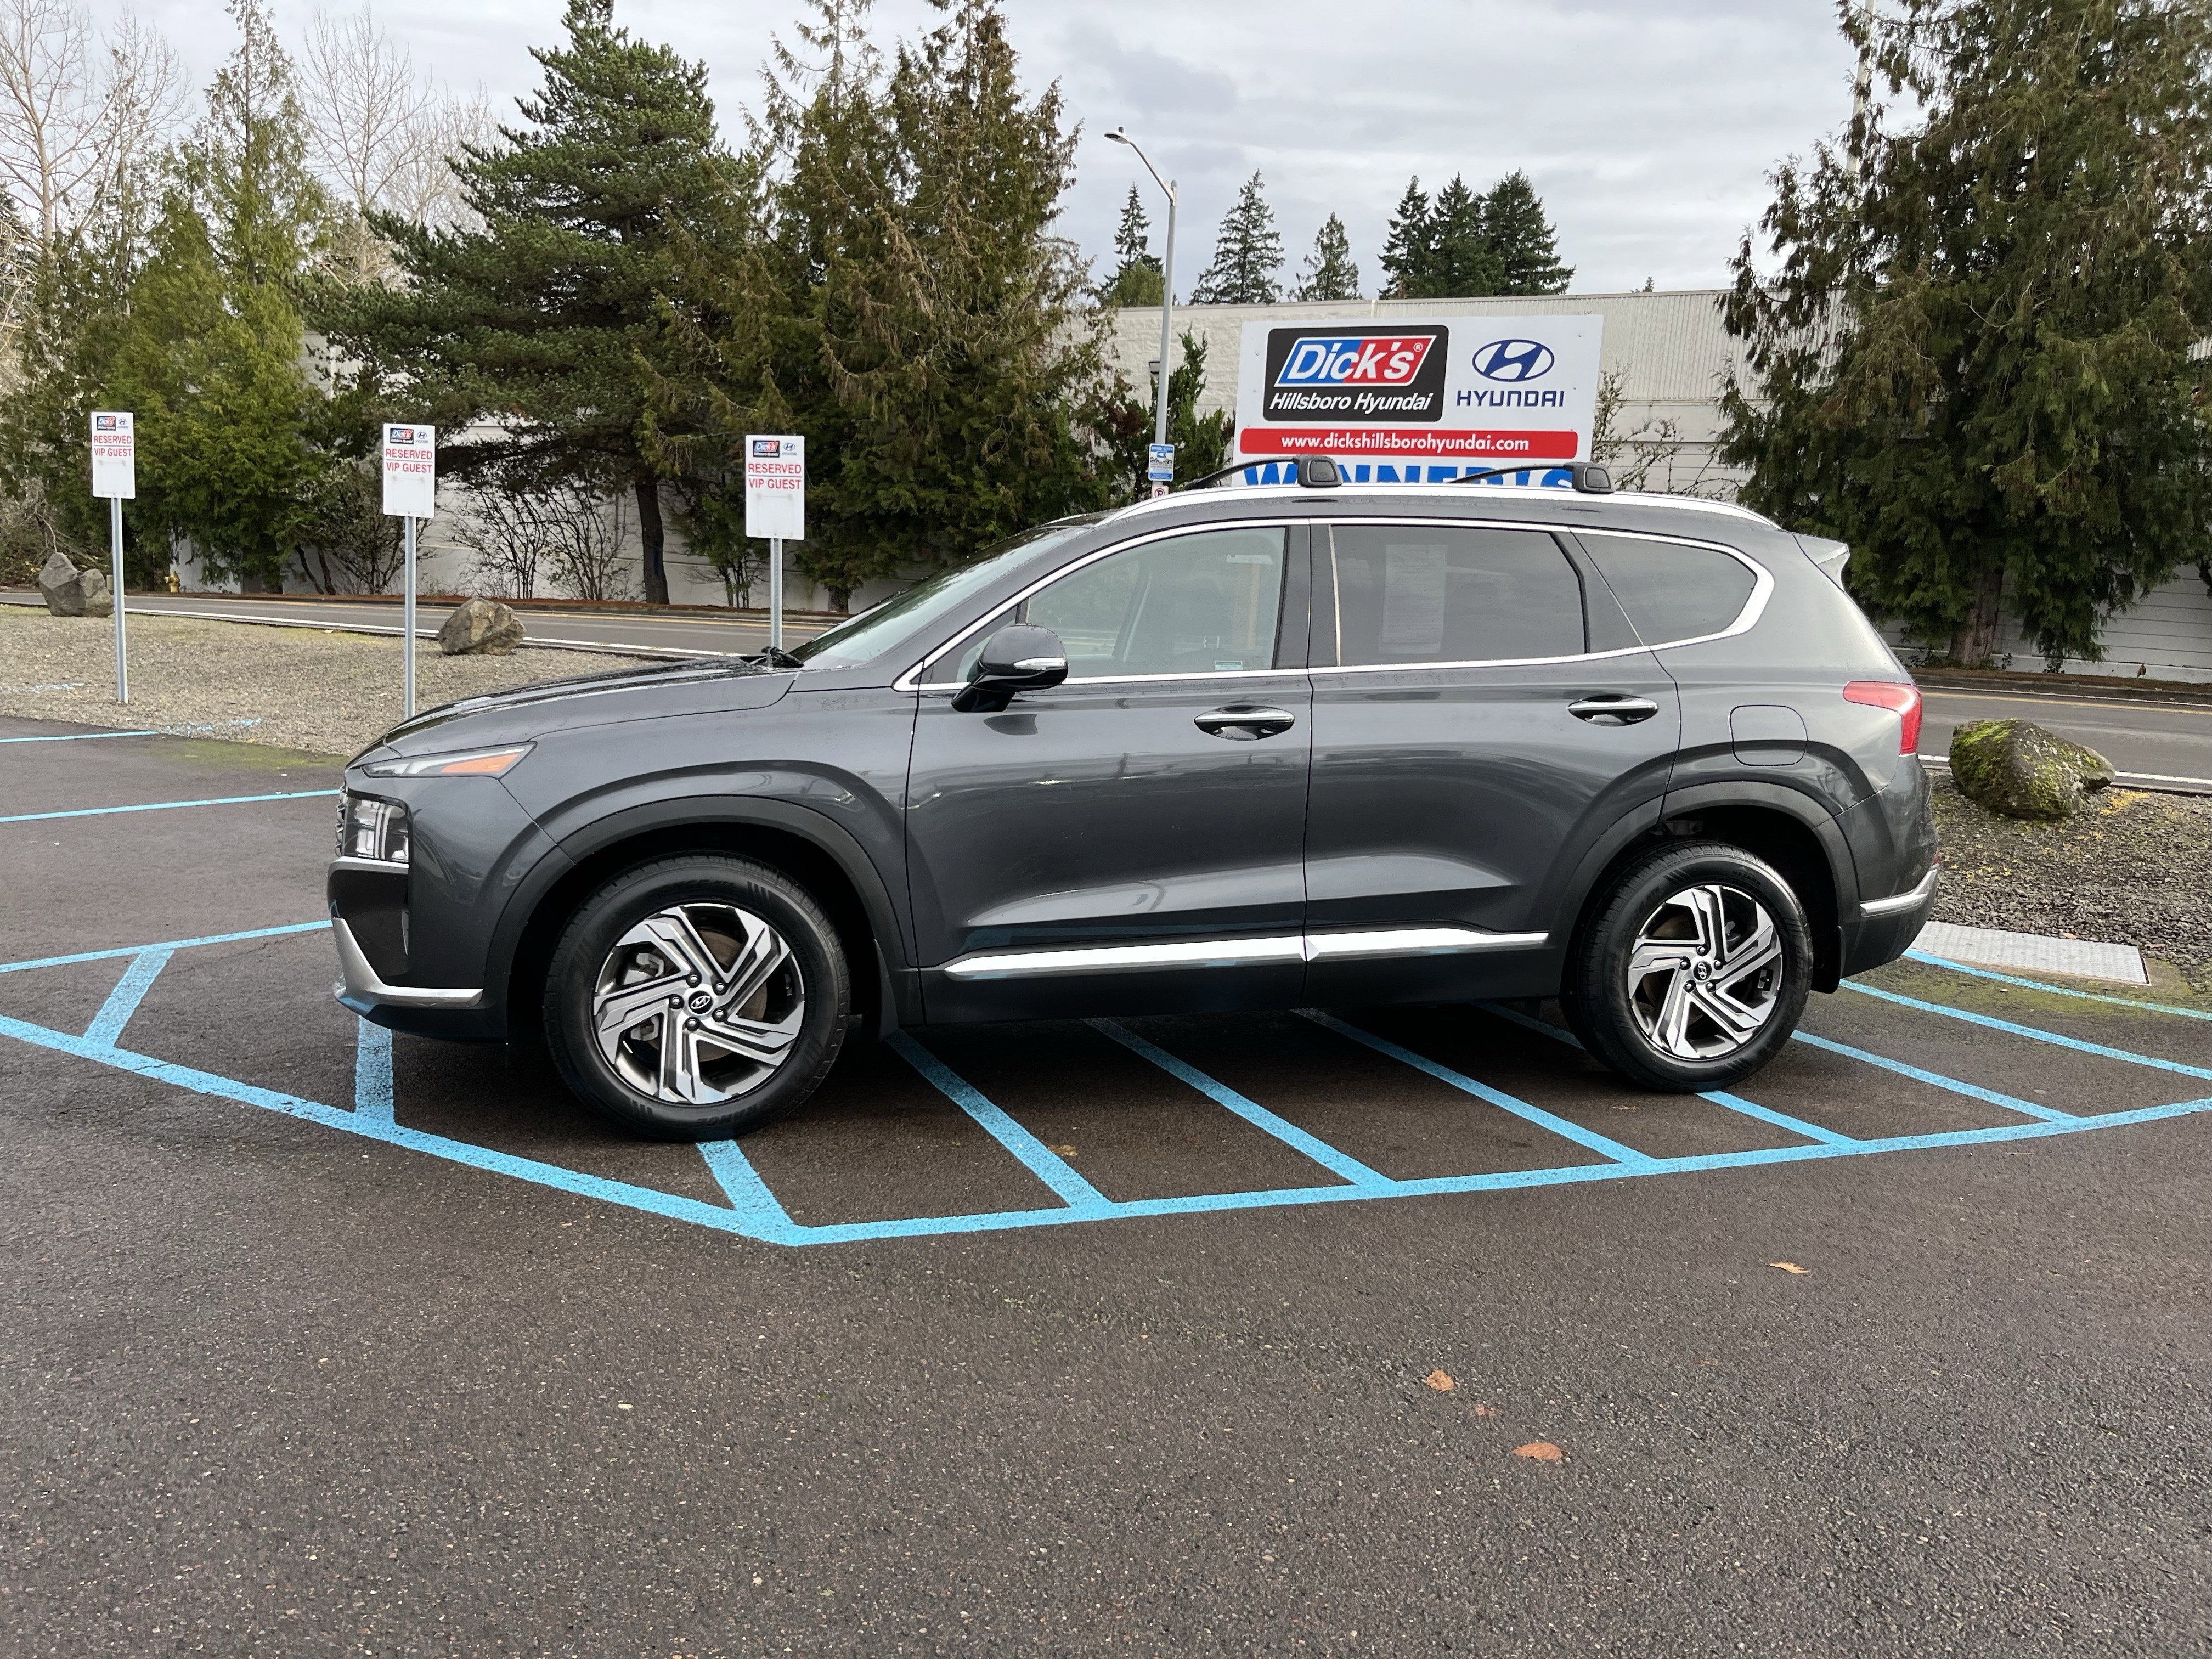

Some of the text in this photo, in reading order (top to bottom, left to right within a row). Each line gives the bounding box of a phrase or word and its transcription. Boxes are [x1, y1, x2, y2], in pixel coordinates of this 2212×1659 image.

[1287, 341, 1414, 380] Dick's
[1269, 392, 1434, 414] Hillsboro Hyundai
[1456, 390, 1565, 407] HYUNDAI
[93, 435, 132, 444] RESERVED
[1281, 432, 1529, 453] www.dickshillsborohyundai.com
[94, 448, 132, 457] VIP GUEST
[386, 448, 433, 460] RESERVED
[386, 462, 432, 474] VIP GUEST
[748, 463, 802, 474] RESERVED
[748, 478, 802, 490] VIP GUEST
